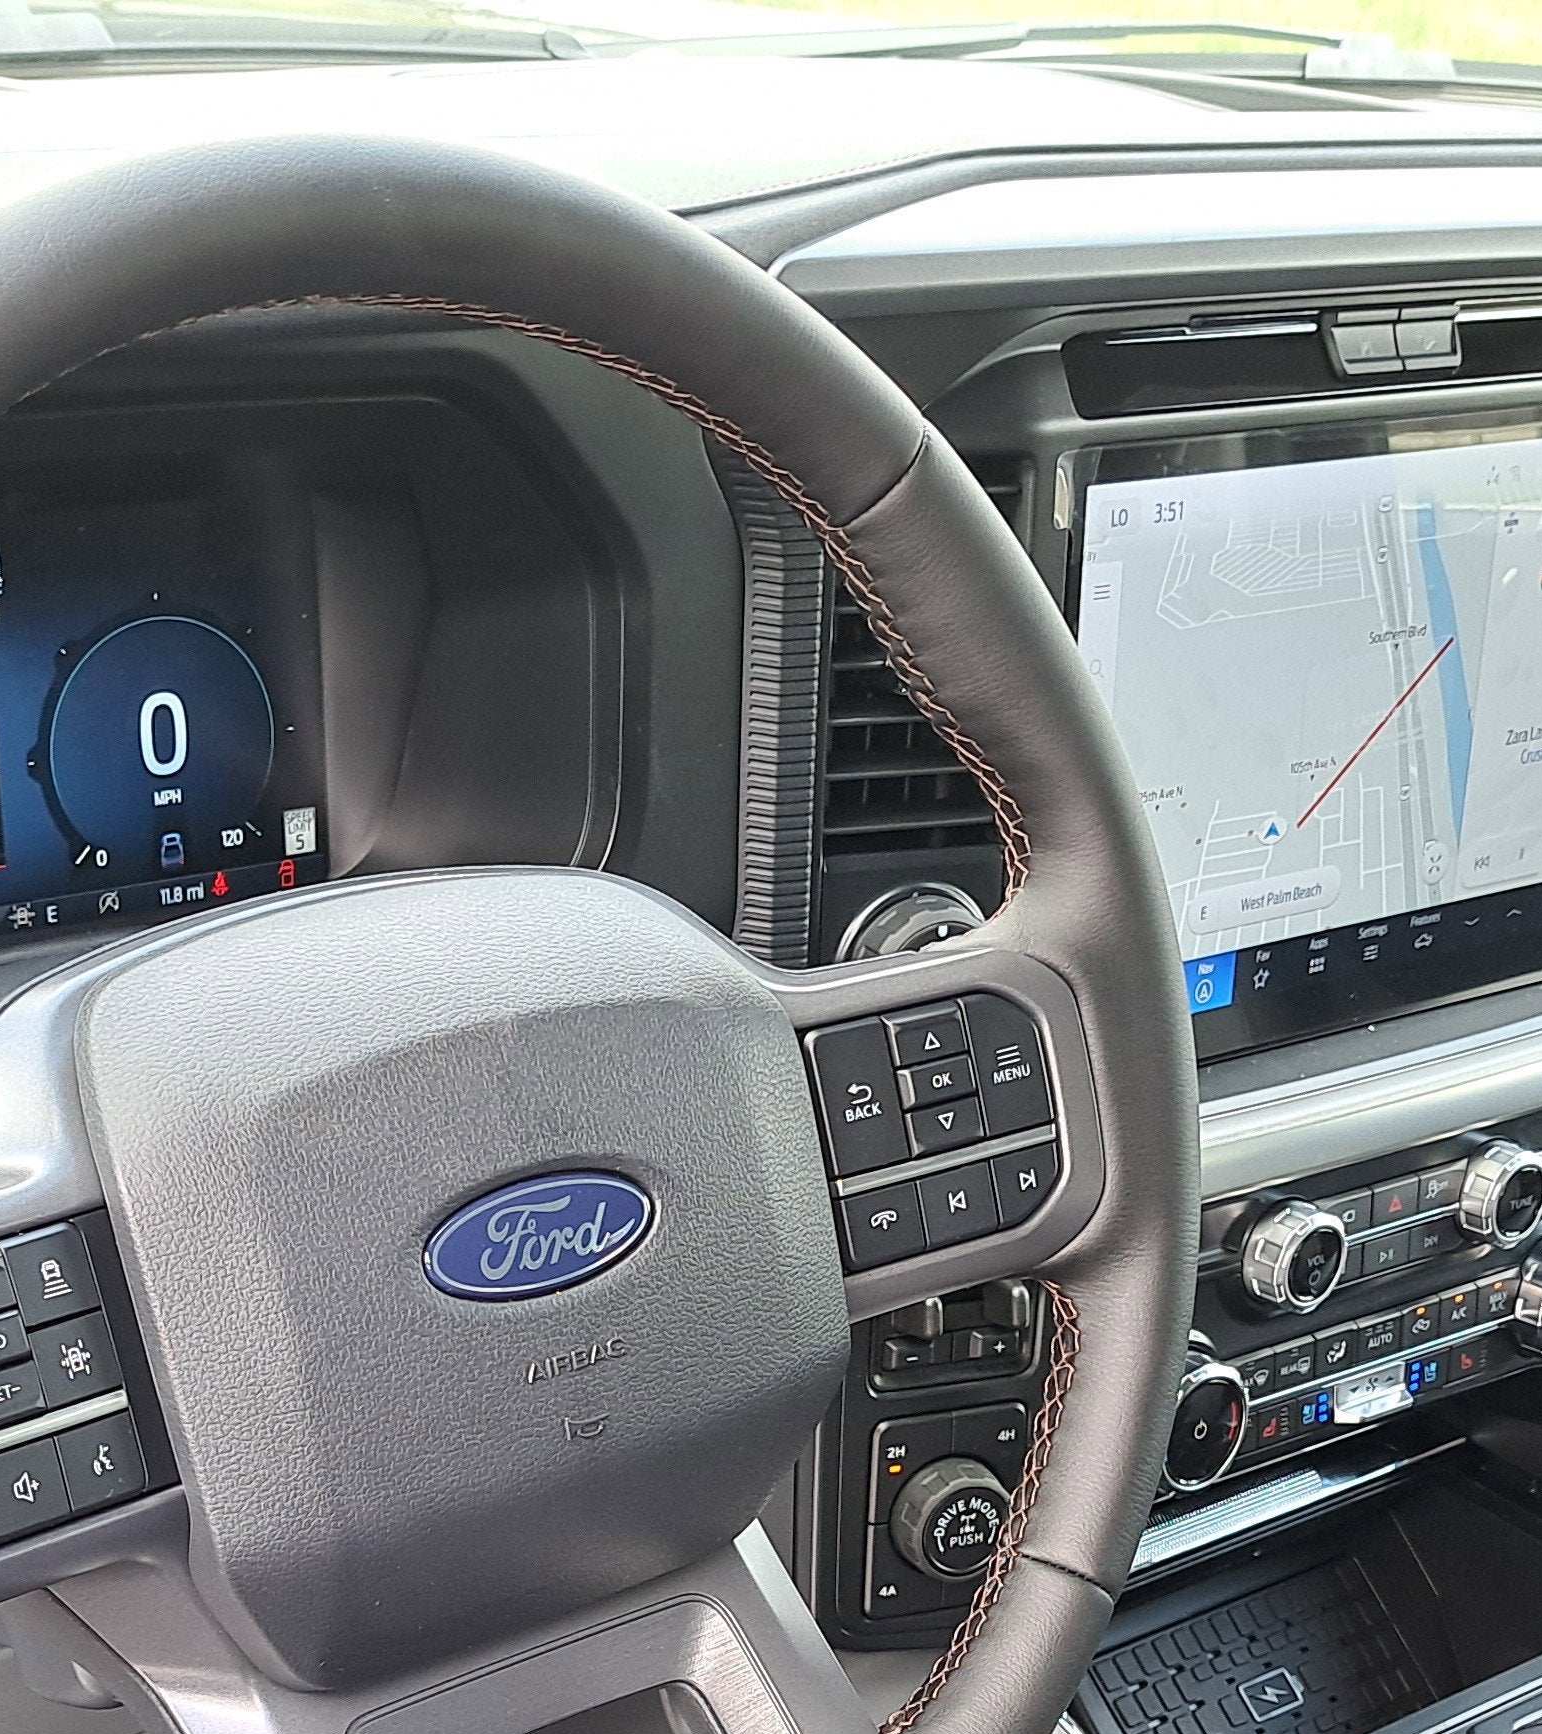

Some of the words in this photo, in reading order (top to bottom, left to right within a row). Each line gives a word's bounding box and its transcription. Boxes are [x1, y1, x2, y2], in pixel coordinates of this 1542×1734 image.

[1110, 509, 1128, 527] LO
[1154, 502, 1184, 524] 3:51
[137, 690, 189, 776] 0
[1505, 729, 1527, 745] Zara
[154, 789, 182, 806] MPH
[221, 829, 243, 847] 120
[96, 850, 108, 867] 0
[186, 882, 204, 901] mi
[1241, 897, 1265, 911] West
[1267, 889, 1292, 908] Palm
[1293, 882, 1322, 900] Beach
[47, 906, 58, 923] E
[932, 1072, 953, 1089] OK
[992, 1063, 1031, 1084] MENU
[845, 1102, 883, 1123] BACK
[480, 1195, 636, 1281] Ford
[1367, 1331, 1393, 1349] AUTO
[526, 1337, 629, 1385] AIRBAG
[997, 1429, 1016, 1441] 4H
[885, 1445, 906, 1459] 2H
[933, 1499, 967, 1537] DRIVE
[968, 1496, 1000, 1528] MODE
[949, 1533, 984, 1548] PUSH
[878, 1585, 897, 1597] 4A
